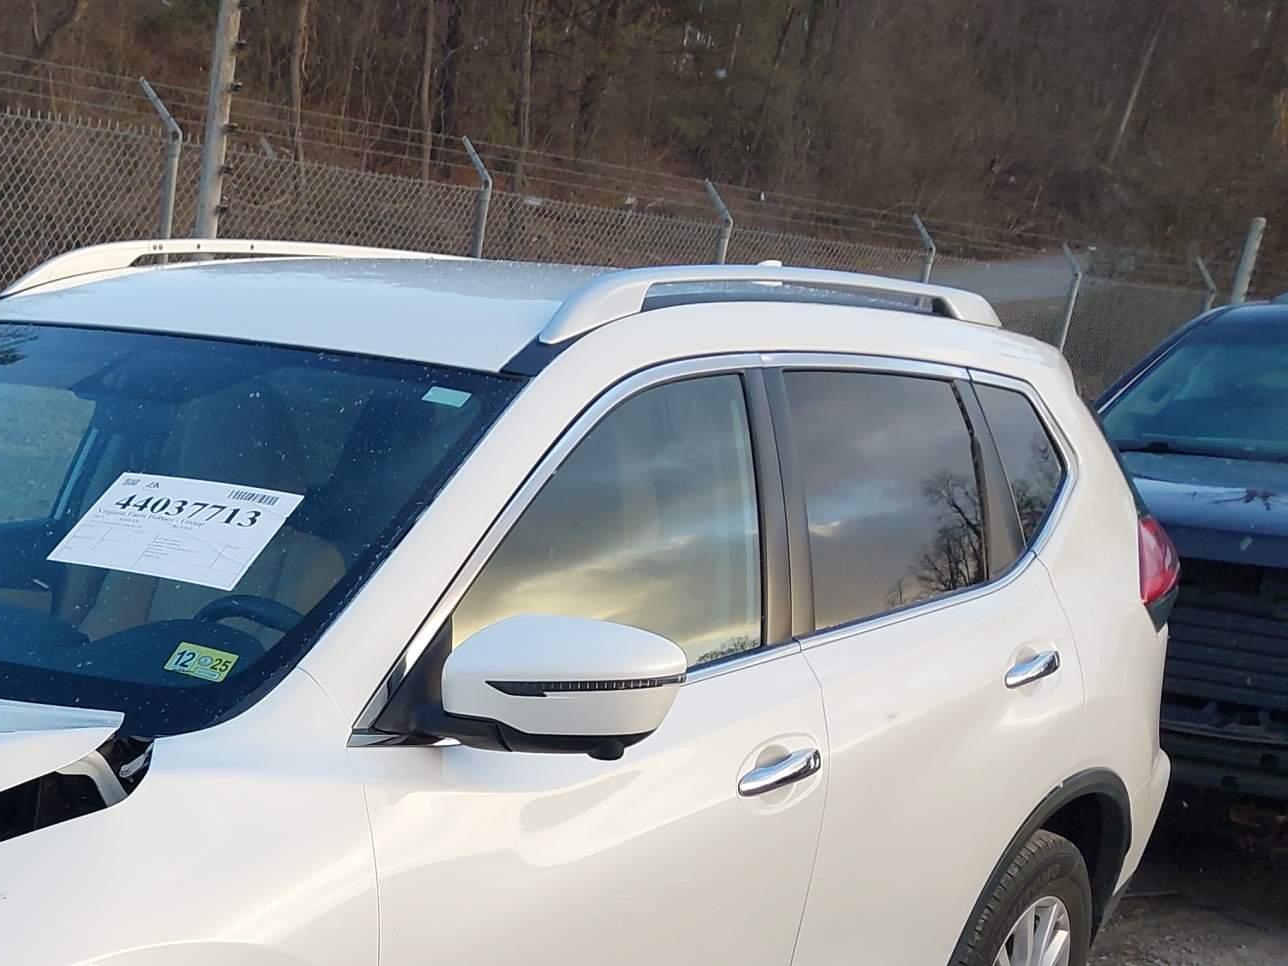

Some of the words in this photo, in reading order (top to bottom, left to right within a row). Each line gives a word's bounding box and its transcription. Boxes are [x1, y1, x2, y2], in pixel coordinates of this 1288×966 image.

[115, 494, 262, 528] 44037713
[174, 650, 196, 668] 12
[211, 658, 232, 673] 25
